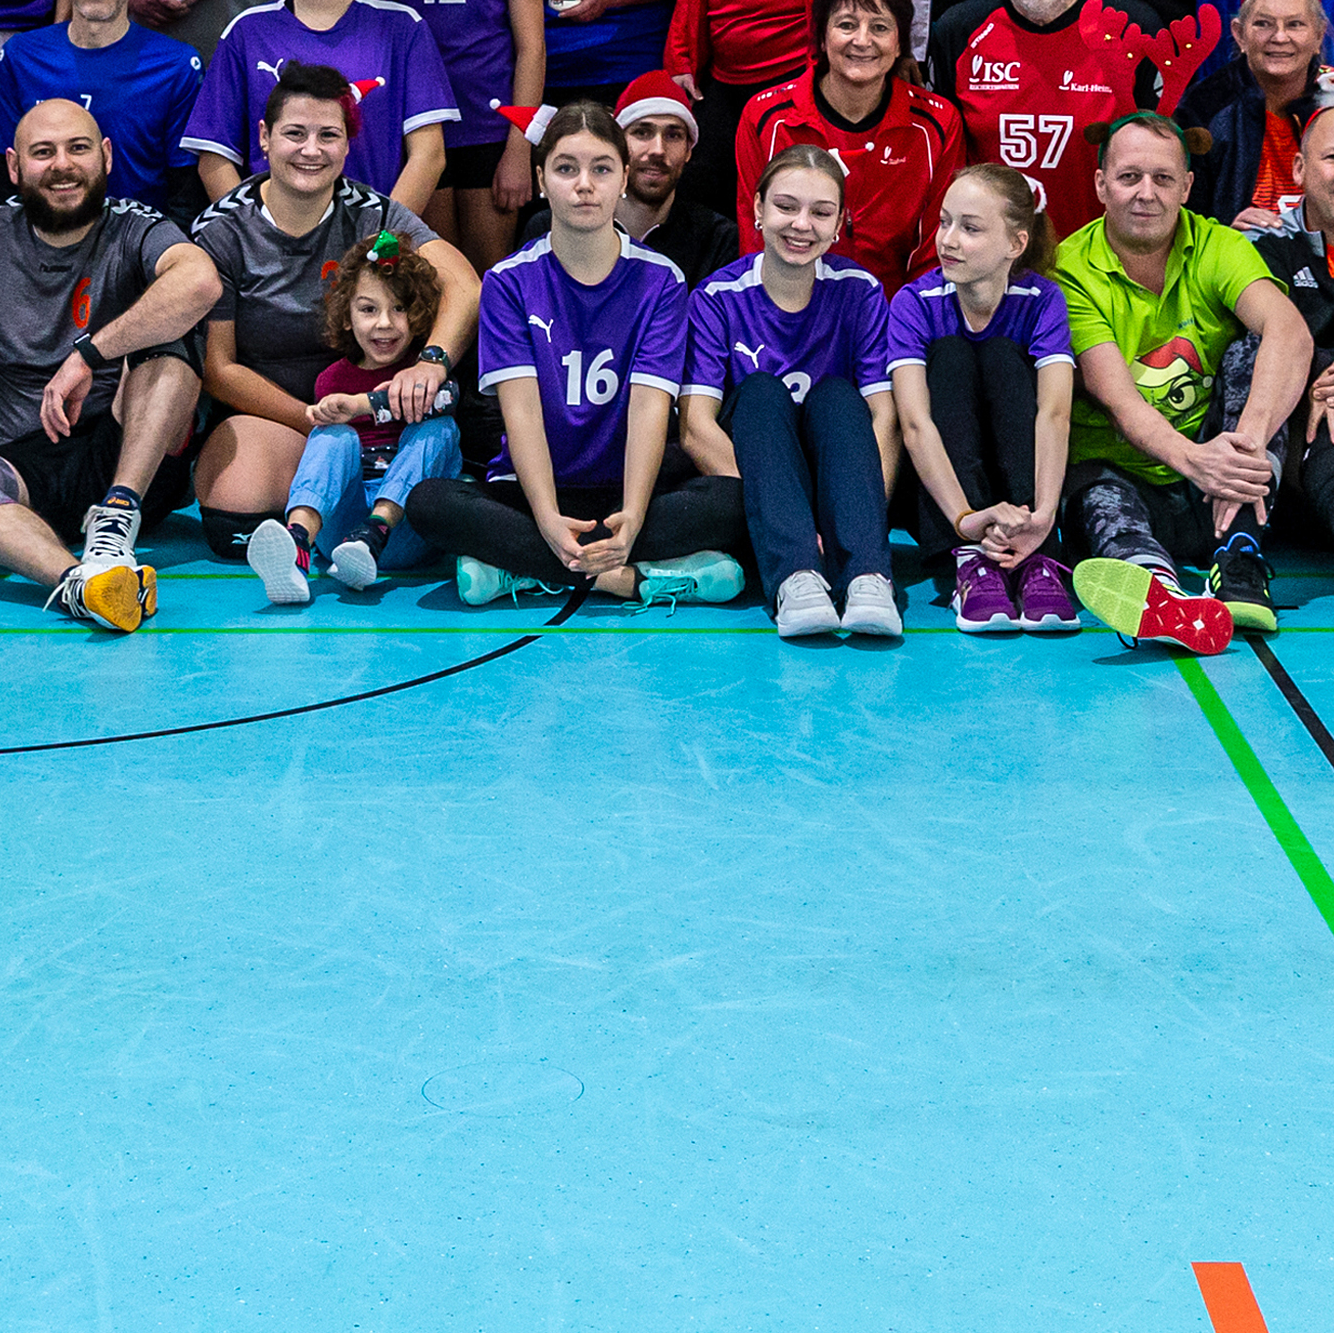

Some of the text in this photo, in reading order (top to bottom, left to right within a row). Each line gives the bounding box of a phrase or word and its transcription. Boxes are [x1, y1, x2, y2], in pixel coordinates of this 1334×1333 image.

[982, 61, 1021, 83] ISC
[998, 113, 1074, 169] 57
[72, 276, 92, 330] 6
[561, 348, 620, 406] 16
